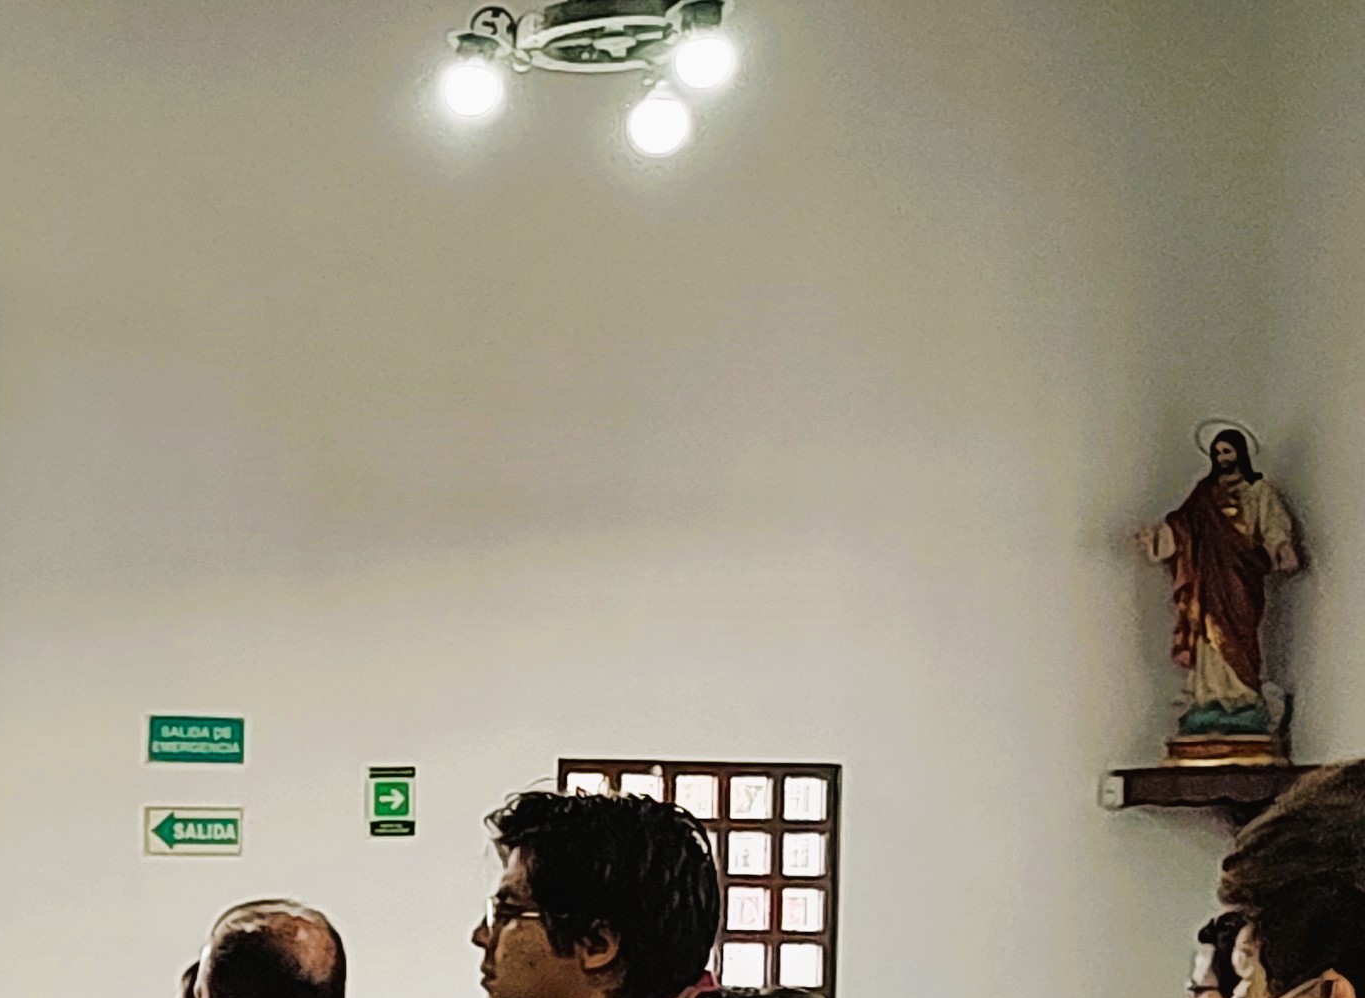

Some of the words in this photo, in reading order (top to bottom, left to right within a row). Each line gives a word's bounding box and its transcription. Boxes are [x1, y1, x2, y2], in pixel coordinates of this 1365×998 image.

[160, 725, 210, 738] SALIDA
[213, 726, 232, 741] DE
[173, 822, 236, 840] SALIDA
